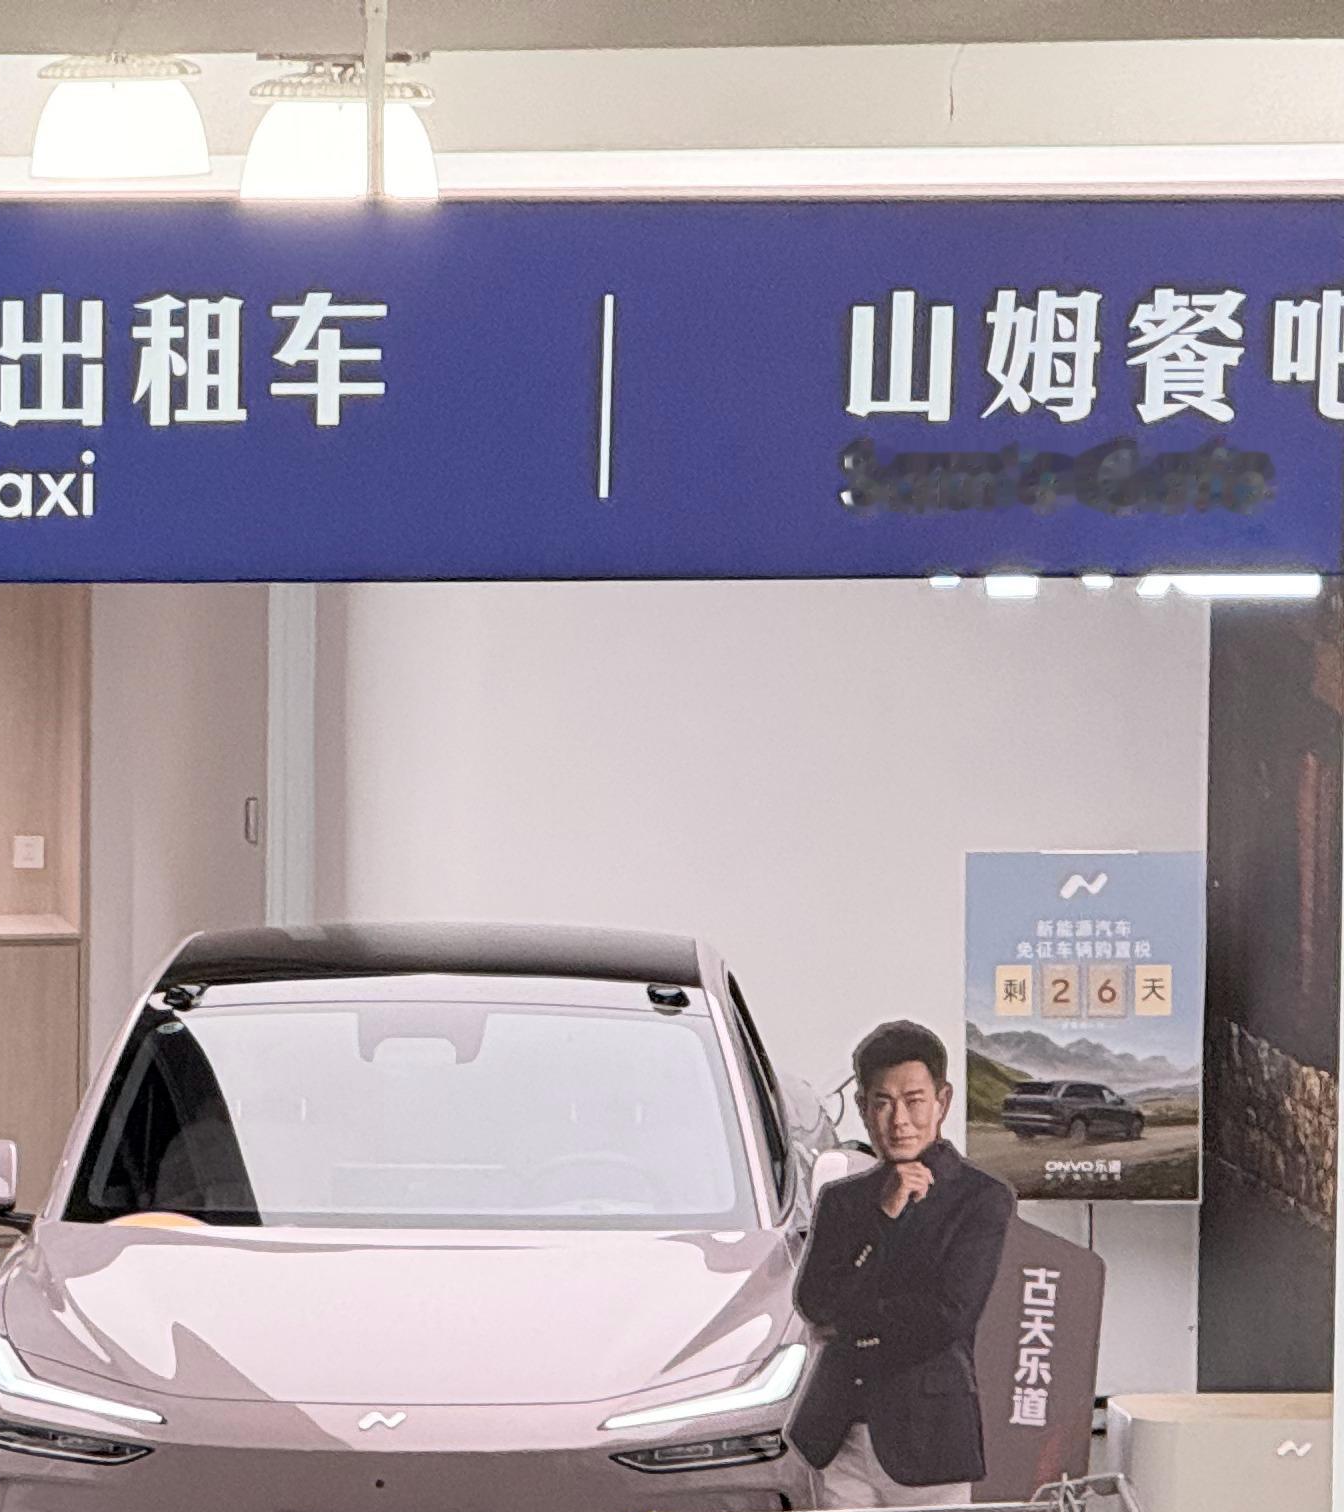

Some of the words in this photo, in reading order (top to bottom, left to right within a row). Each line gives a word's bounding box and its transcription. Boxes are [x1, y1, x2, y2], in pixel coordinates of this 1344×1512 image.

[1036, 919, 1133, 938] 新能源汽车
[1016, 939, 1153, 958] 免征车辆购置税
[1003, 977, 1027, 1003] 剩
[1051, 978, 1071, 1004] 2
[1097, 979, 1117, 1005] 6
[1142, 977, 1166, 1002] 天
[1009, 1266, 1061, 1427] 古天乐道
